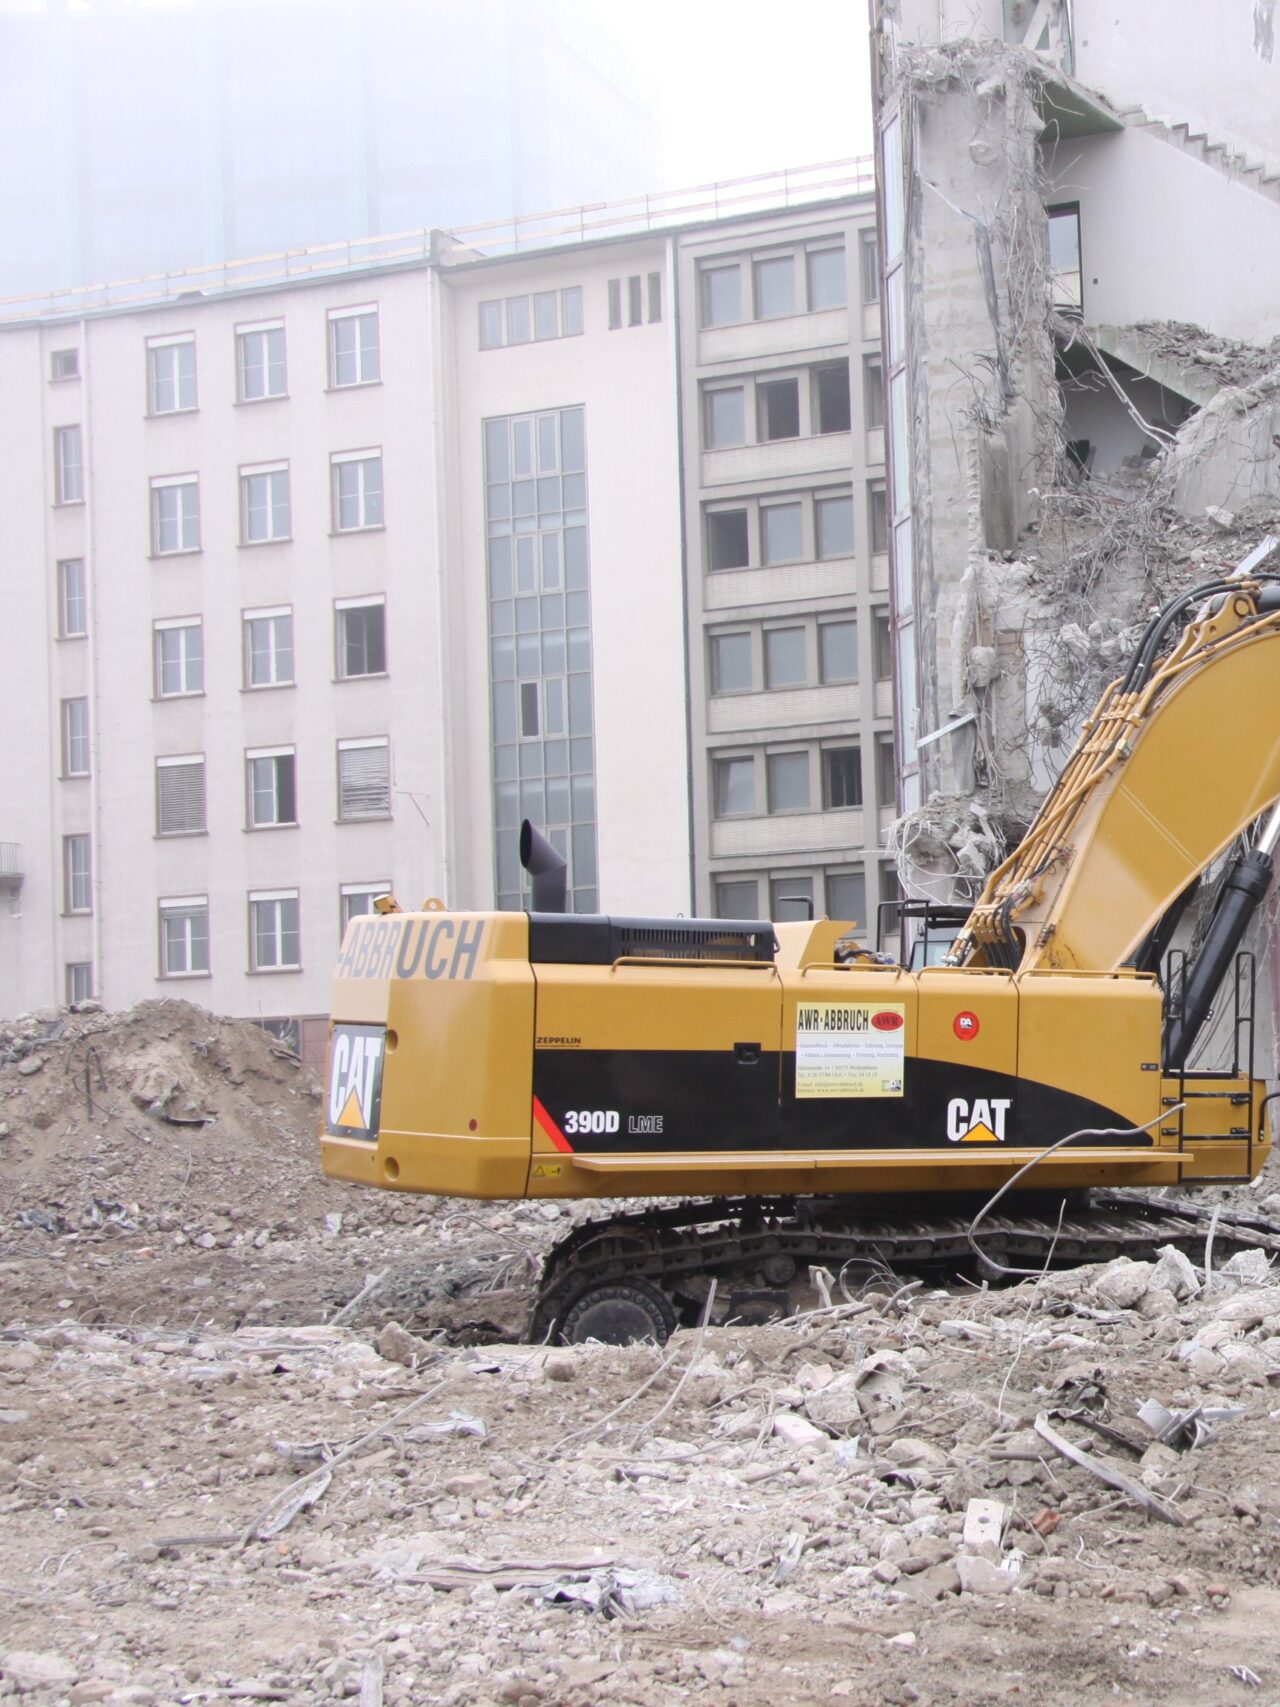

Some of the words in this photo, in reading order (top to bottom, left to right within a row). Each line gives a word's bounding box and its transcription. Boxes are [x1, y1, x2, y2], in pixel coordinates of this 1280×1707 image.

[537, 1036, 581, 1044] ZEPPELIN
[330, 1034, 381, 1130] CAT
[565, 1110, 620, 1133] 390D
[628, 1115, 663, 1133] LME
[947, 1098, 1010, 1141] CAT
